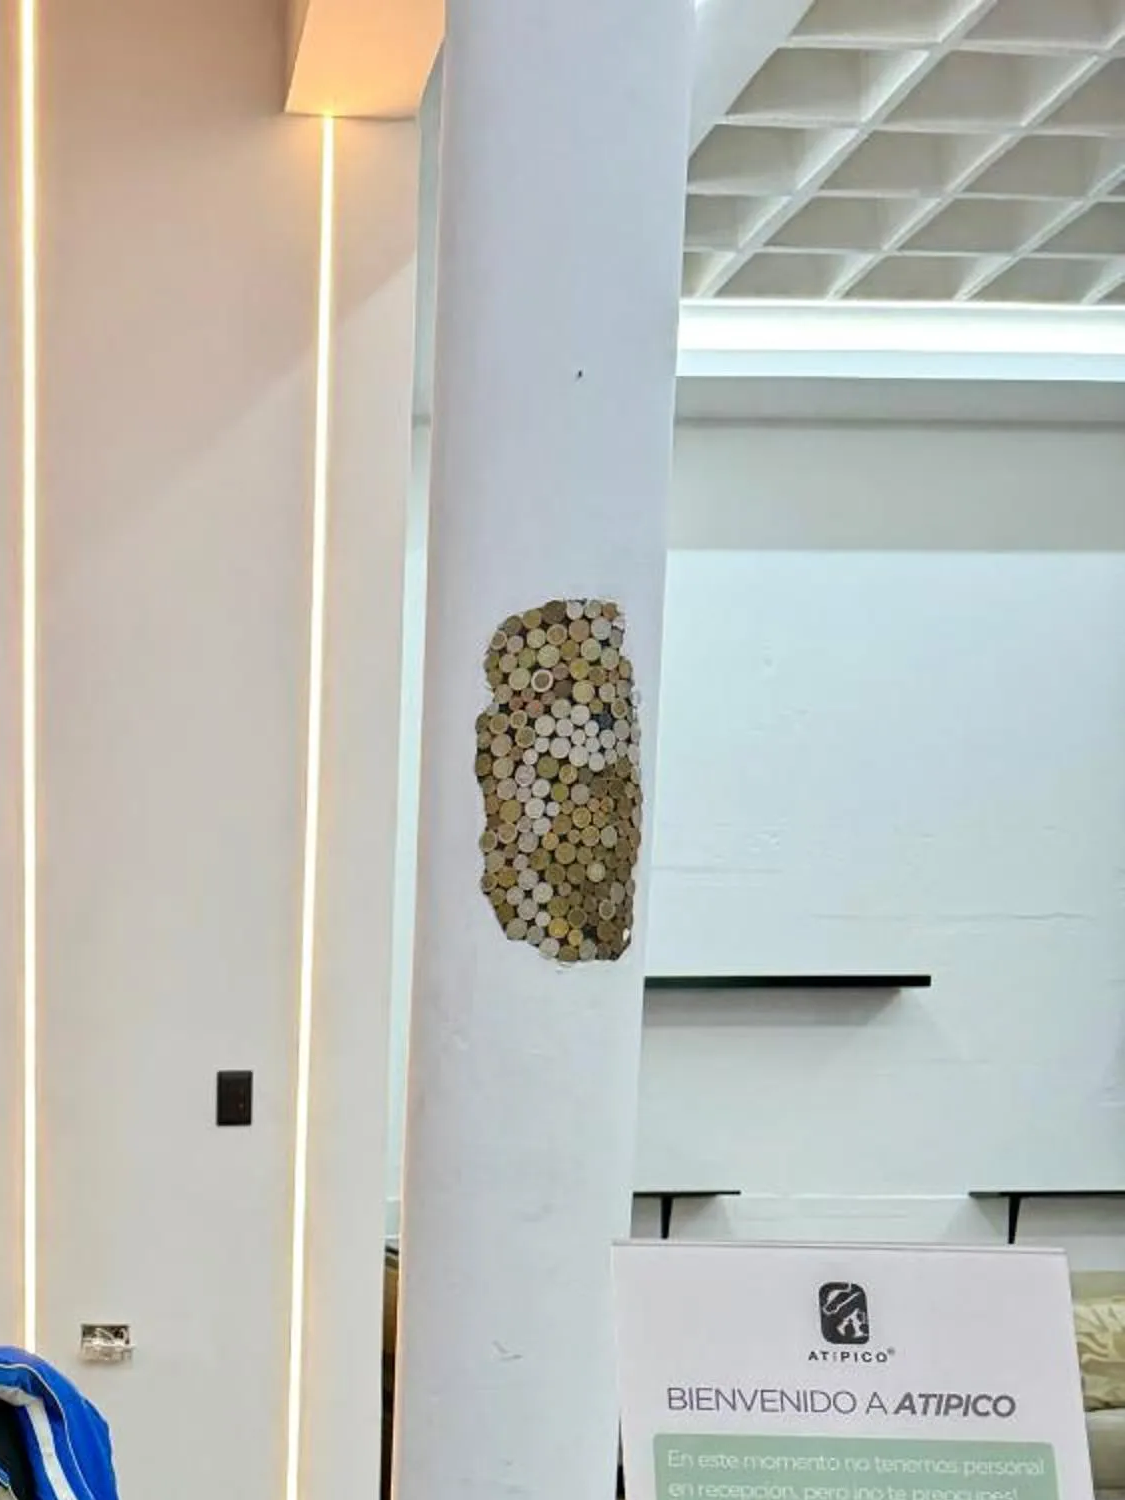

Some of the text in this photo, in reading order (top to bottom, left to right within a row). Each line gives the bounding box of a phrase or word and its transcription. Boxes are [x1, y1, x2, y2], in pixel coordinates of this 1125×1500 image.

[667, 1386, 1017, 1418] BIENVENIDO A ATIPICO
[668, 1449, 1046, 1479] En este momento no tenemos personal
[668, 1482, 695, 1499] en
